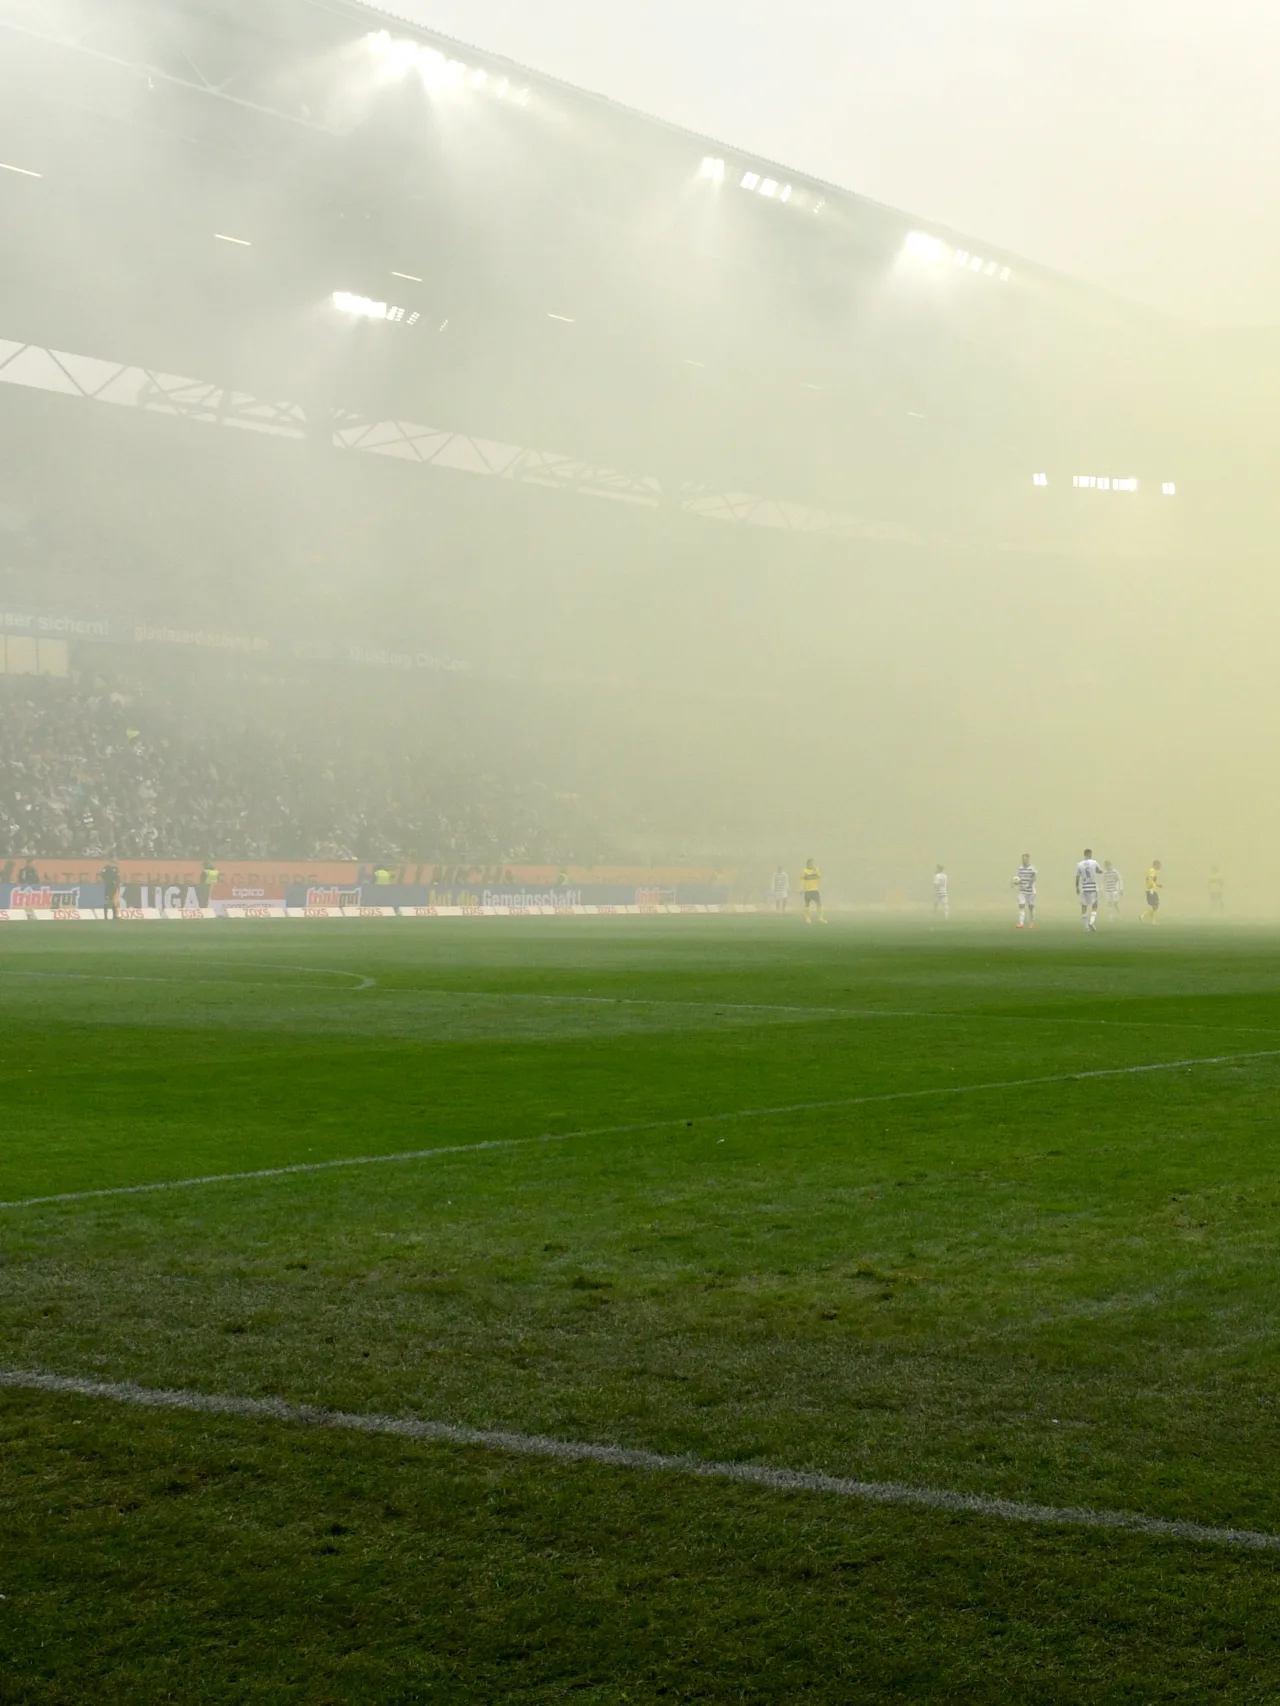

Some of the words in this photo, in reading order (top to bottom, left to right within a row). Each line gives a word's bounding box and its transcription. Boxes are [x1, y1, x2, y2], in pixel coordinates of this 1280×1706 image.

[0, 612, 33, 628] ser
[37, 614, 109, 636] sichern!
[11, 886, 80, 910] trinkgut
[140, 886, 200, 910] LIGA
[232, 886, 265, 898] tipico
[118, 909, 144, 920] OXS
